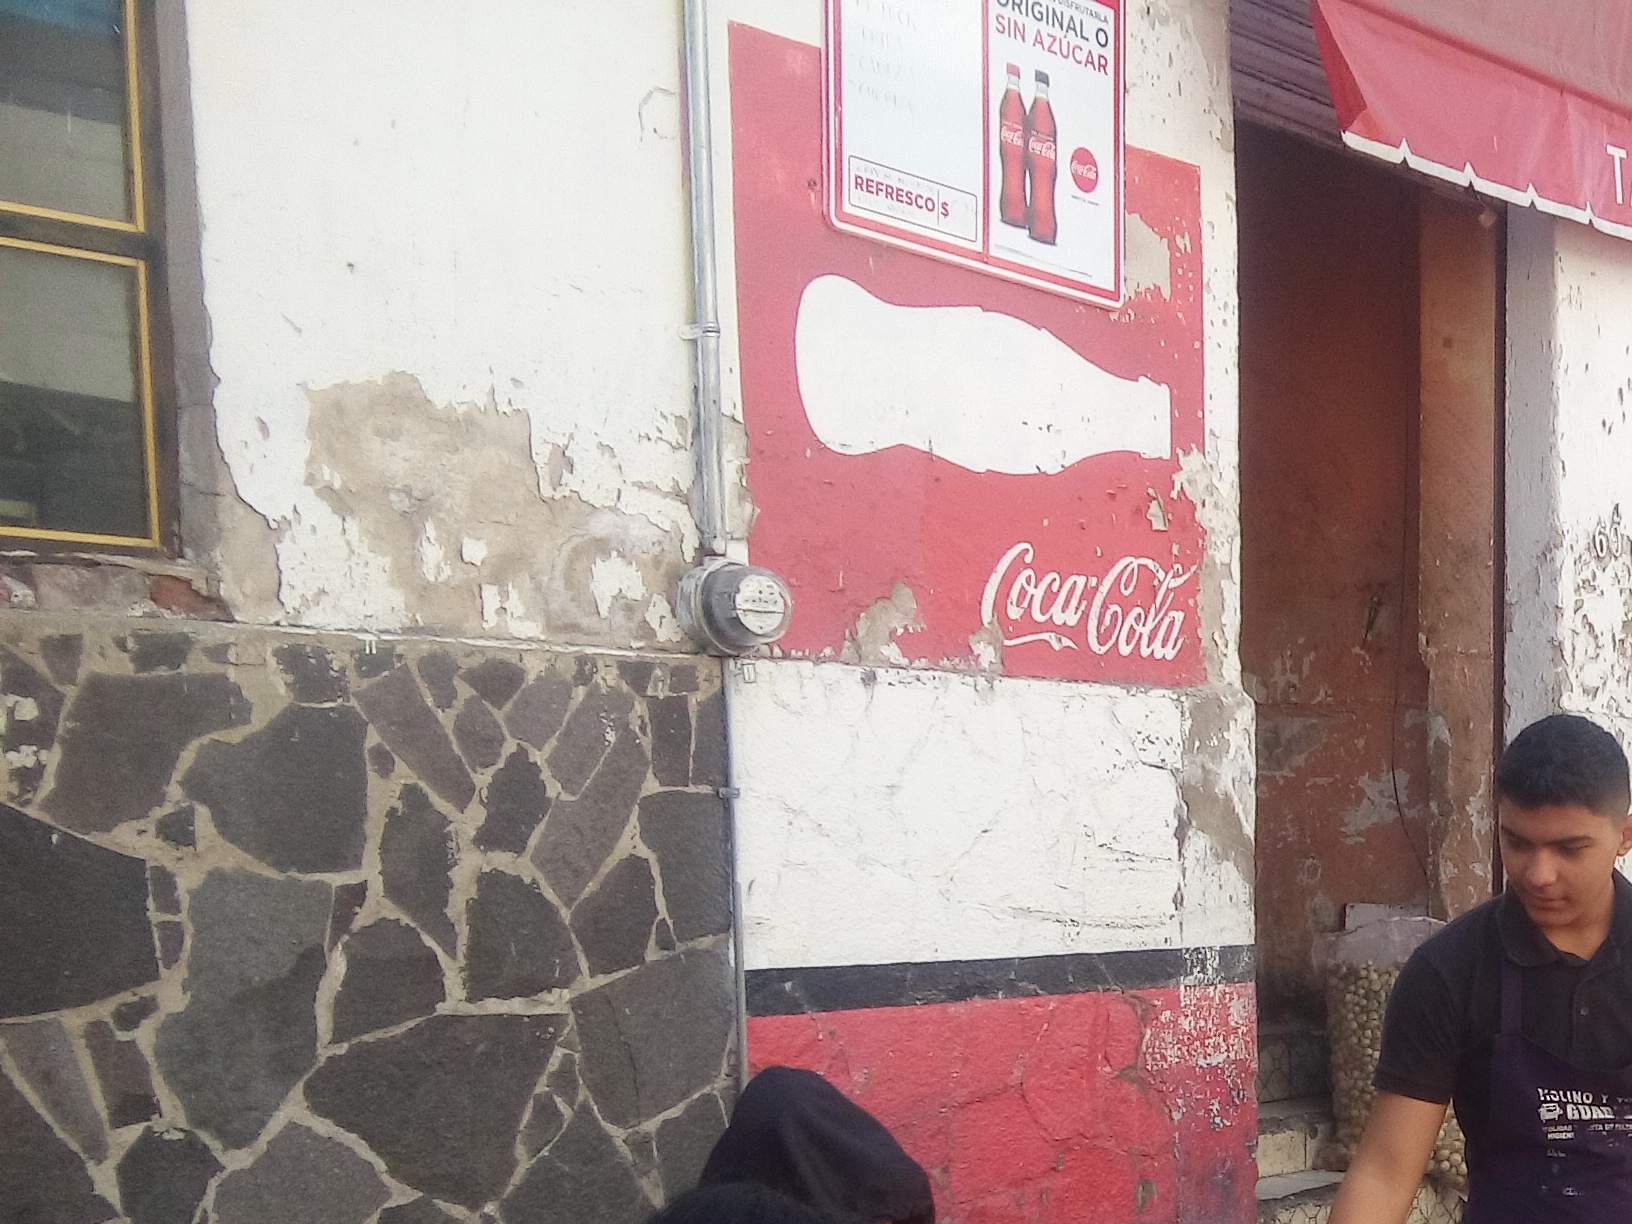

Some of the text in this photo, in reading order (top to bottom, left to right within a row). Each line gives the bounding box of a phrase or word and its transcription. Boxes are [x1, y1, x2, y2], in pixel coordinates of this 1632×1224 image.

[995, 13, 1109, 76] SIN AZÚCAR
[1095, 28, 1109, 48] O
[854, 173, 936, 213] REFRESCO
[940, 200, 951, 220] $
[981, 541, 1199, 661] Coca-Cola
